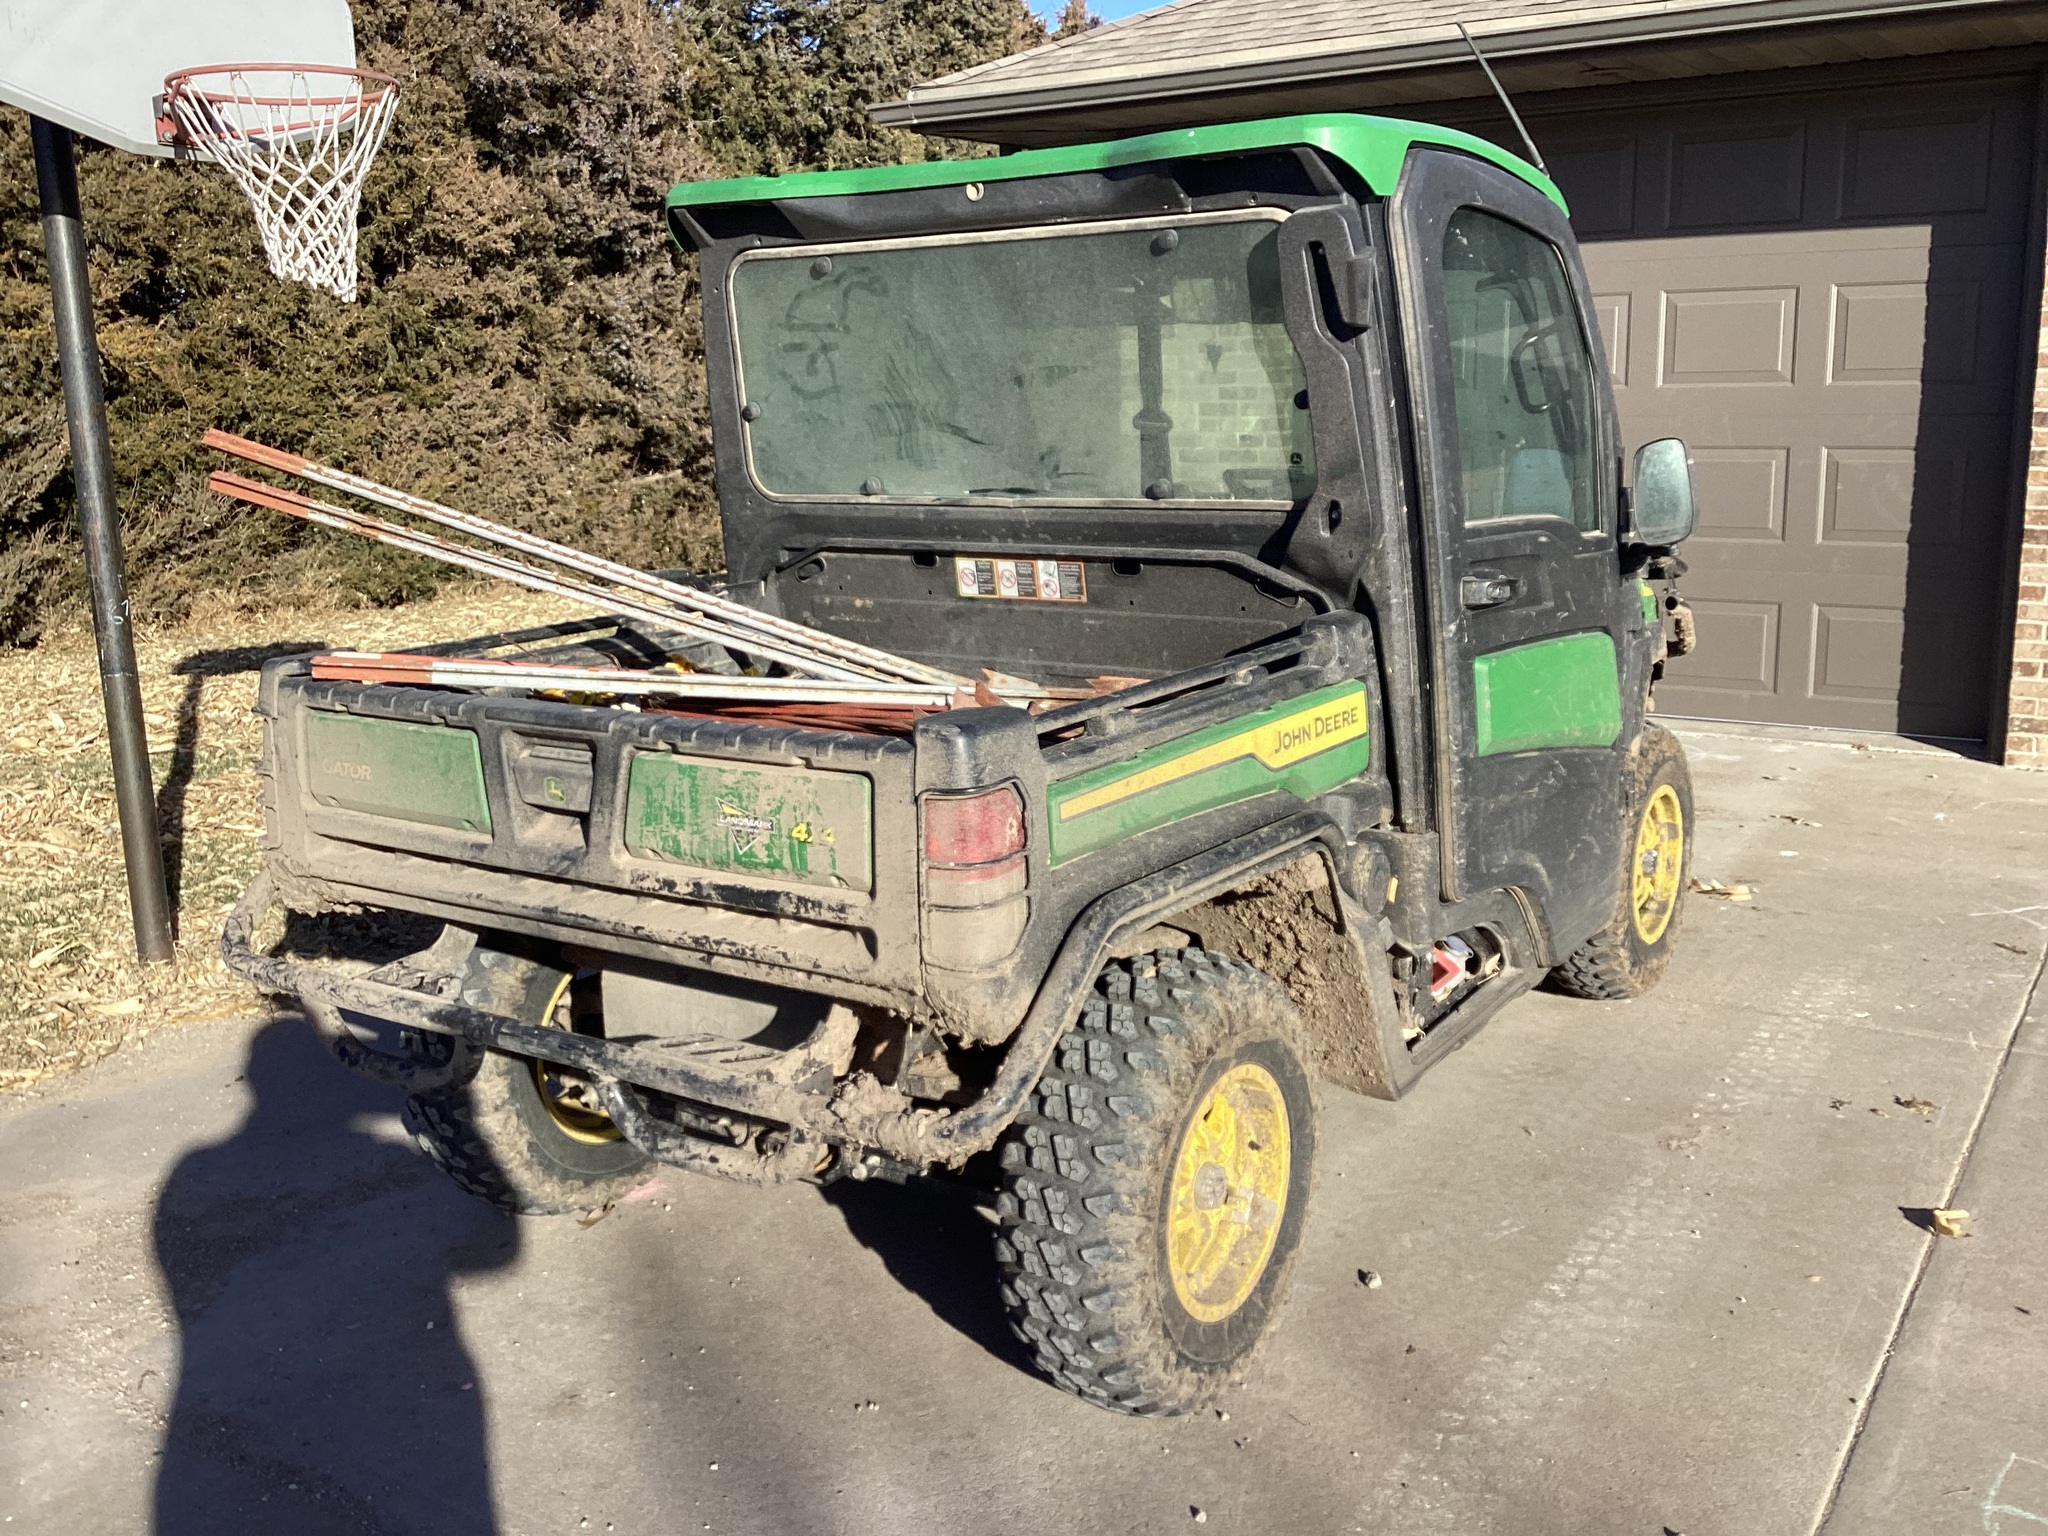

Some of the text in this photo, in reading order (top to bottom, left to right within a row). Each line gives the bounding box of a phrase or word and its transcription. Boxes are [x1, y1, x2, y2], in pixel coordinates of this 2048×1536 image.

[1274, 706, 1359, 754] JOHN DEERE
[322, 757, 372, 782] GATOR
